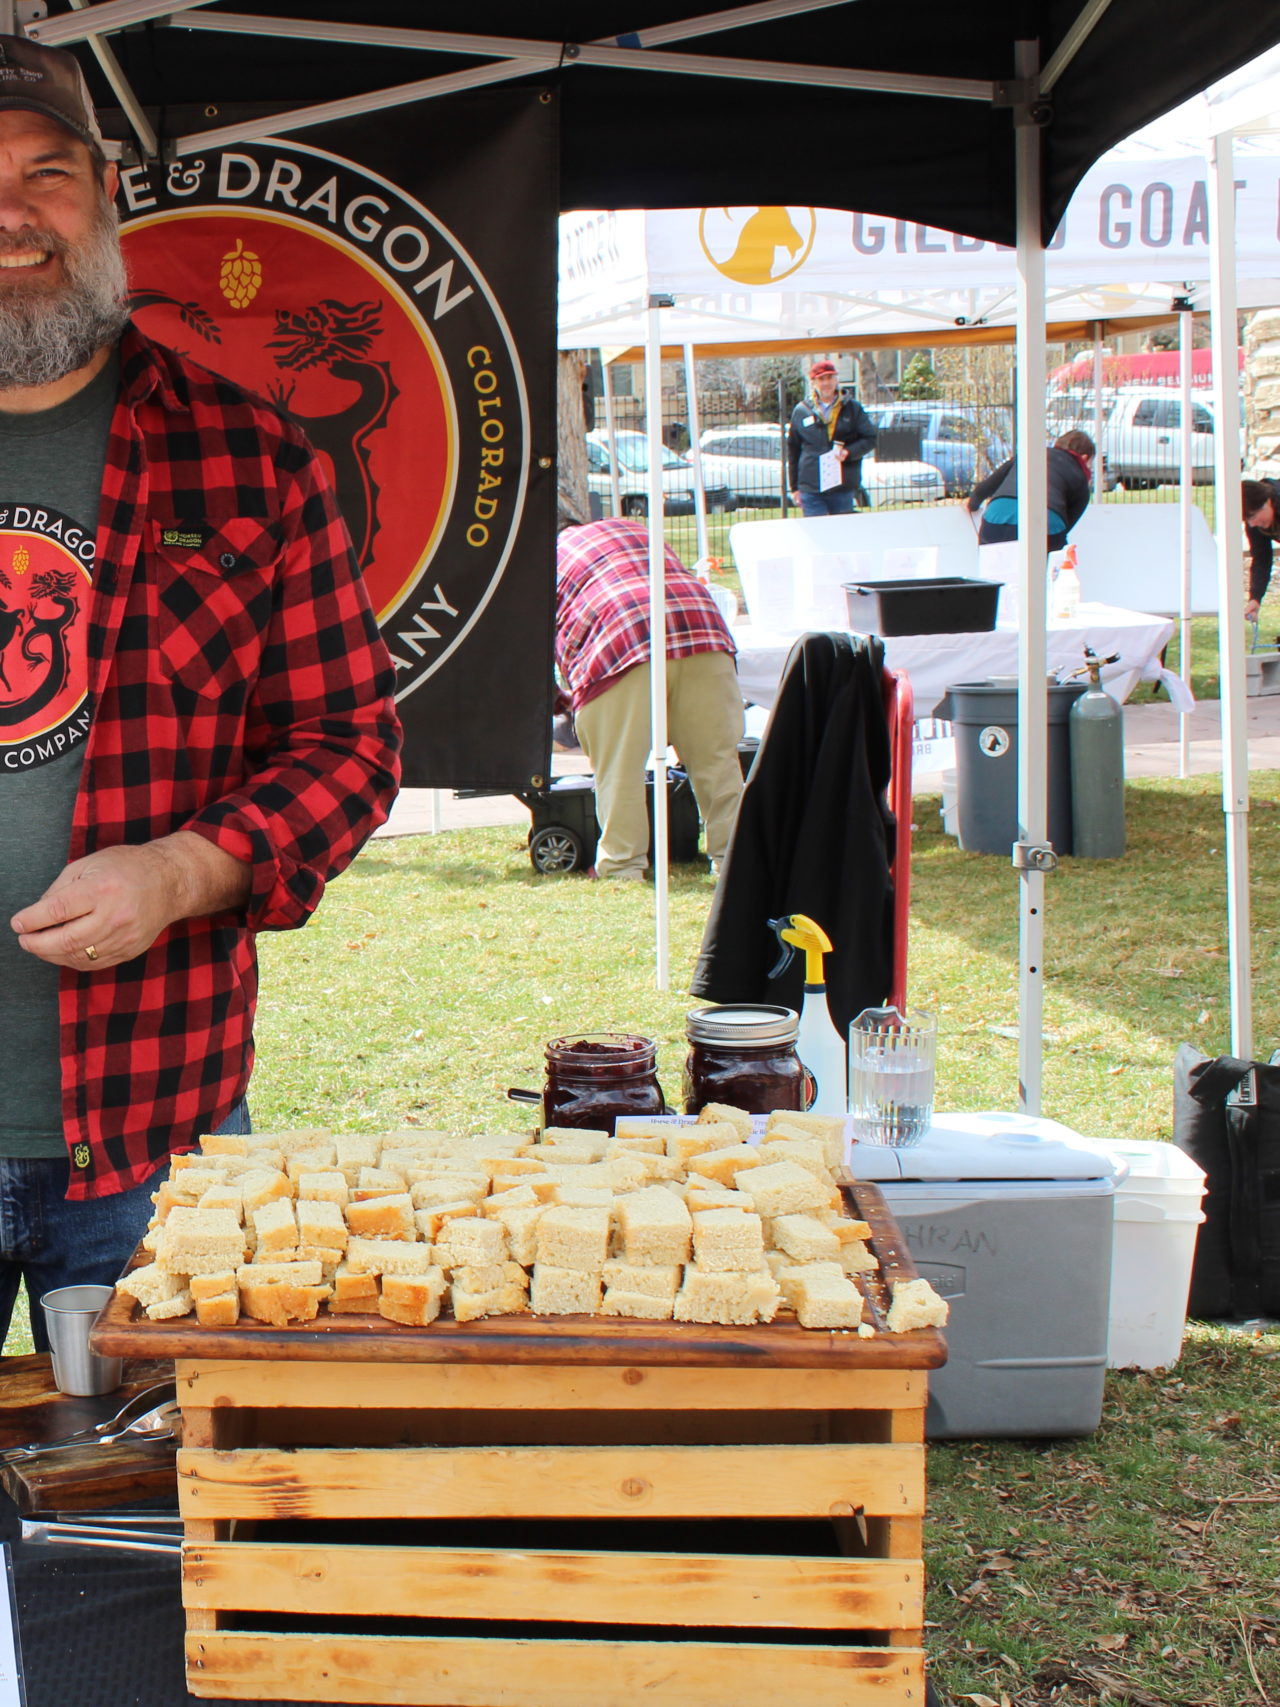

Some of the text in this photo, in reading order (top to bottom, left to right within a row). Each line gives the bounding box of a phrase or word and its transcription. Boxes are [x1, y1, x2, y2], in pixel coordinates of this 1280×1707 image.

[217, 152, 474, 321] DRAGON
[465, 344, 505, 548] COLORADO
[13, 507, 96, 569] DRAGO
[4, 710, 91, 769] COMPAN
